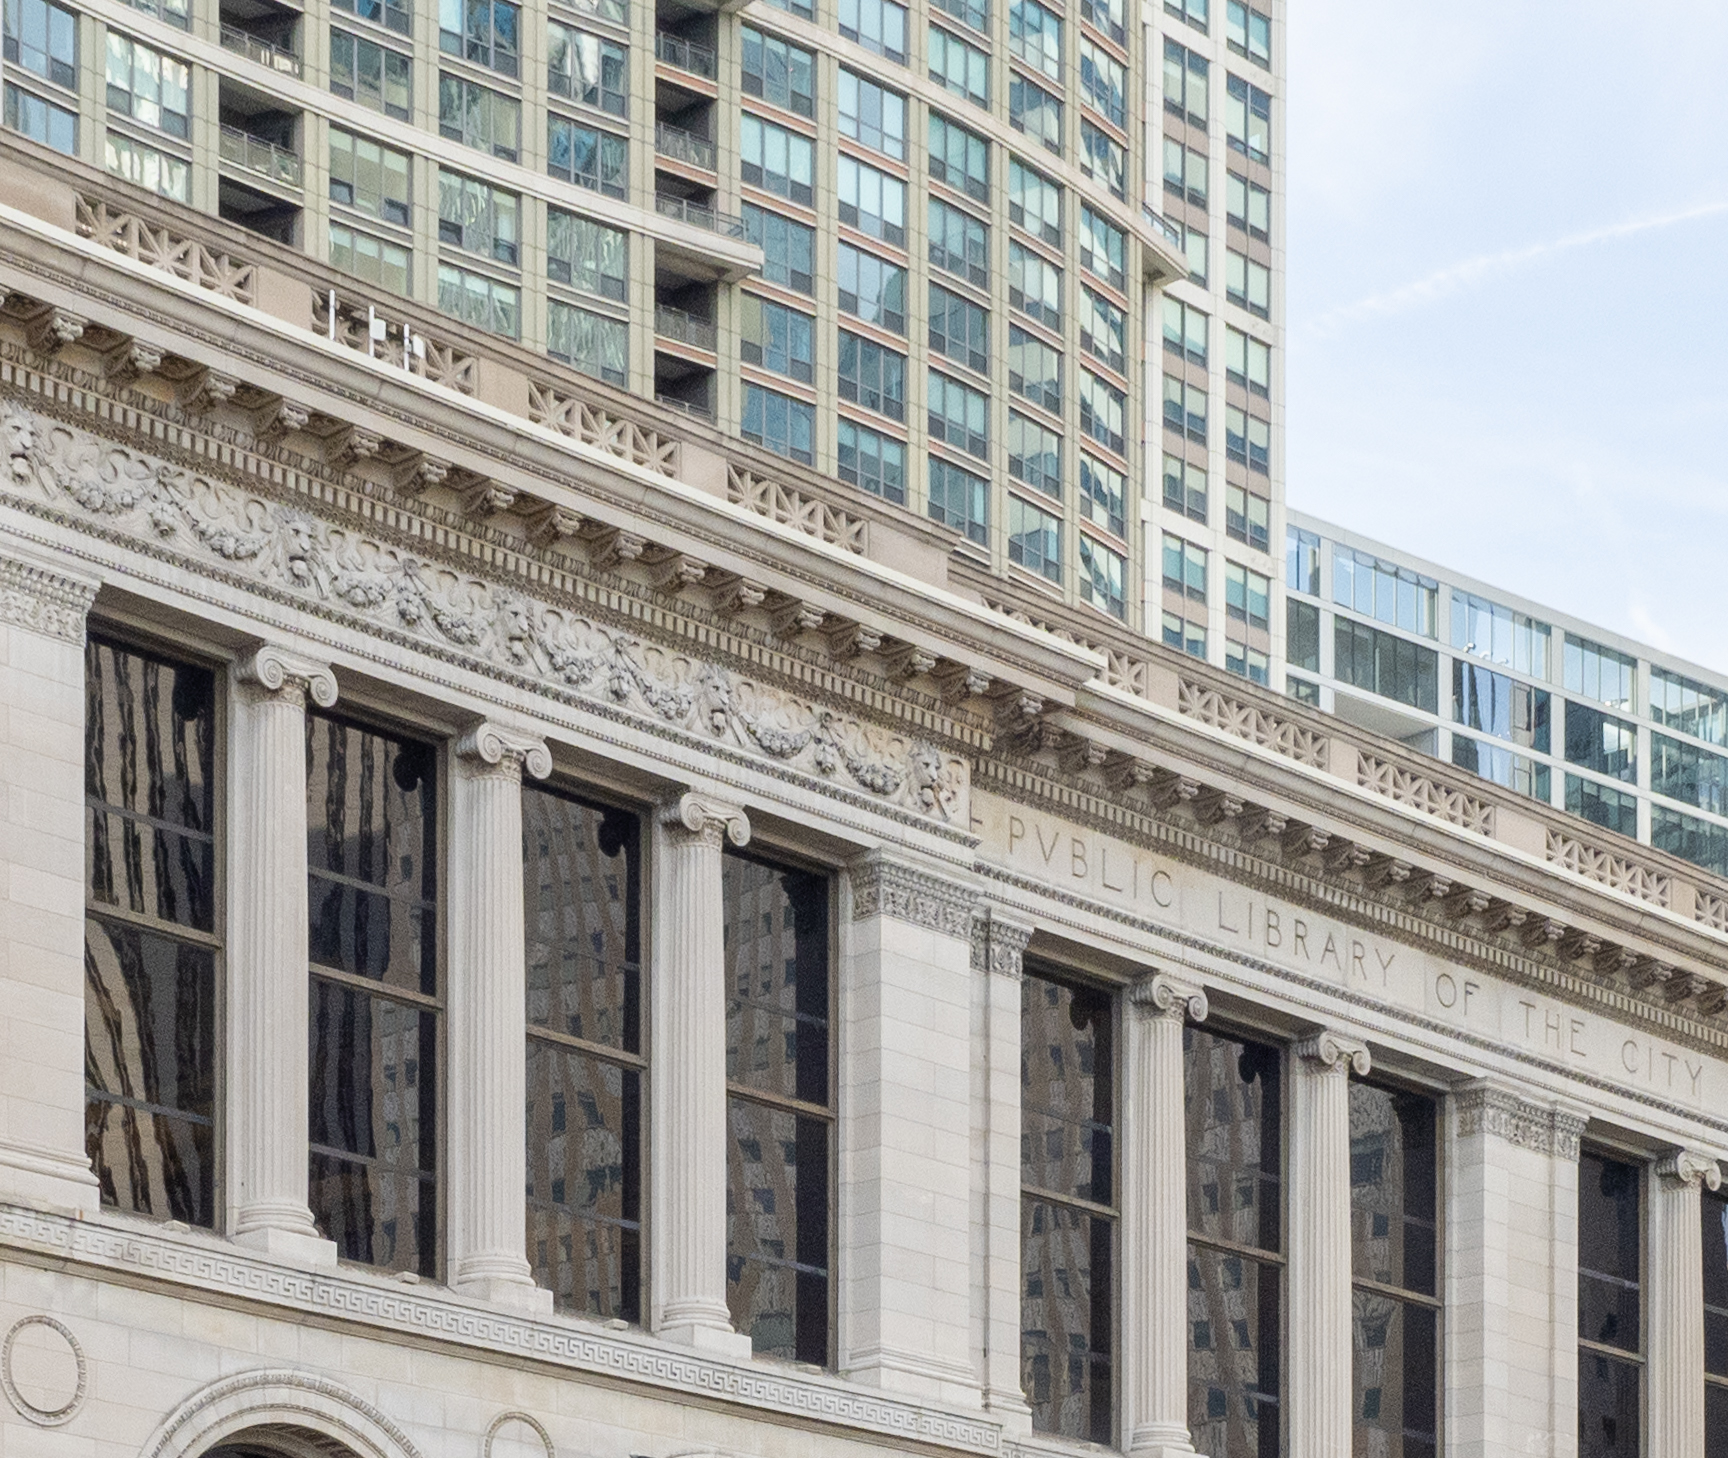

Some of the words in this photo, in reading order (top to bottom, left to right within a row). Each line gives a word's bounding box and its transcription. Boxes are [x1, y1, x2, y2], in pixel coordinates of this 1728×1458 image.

[1008, 814, 1173, 909] PVBLIC
[1217, 890, 1395, 988] LIBRARY
[1434, 972, 1481, 1018] OF
[1518, 1000, 1587, 1058] THE
[1620, 1038, 1704, 1097] CITY
